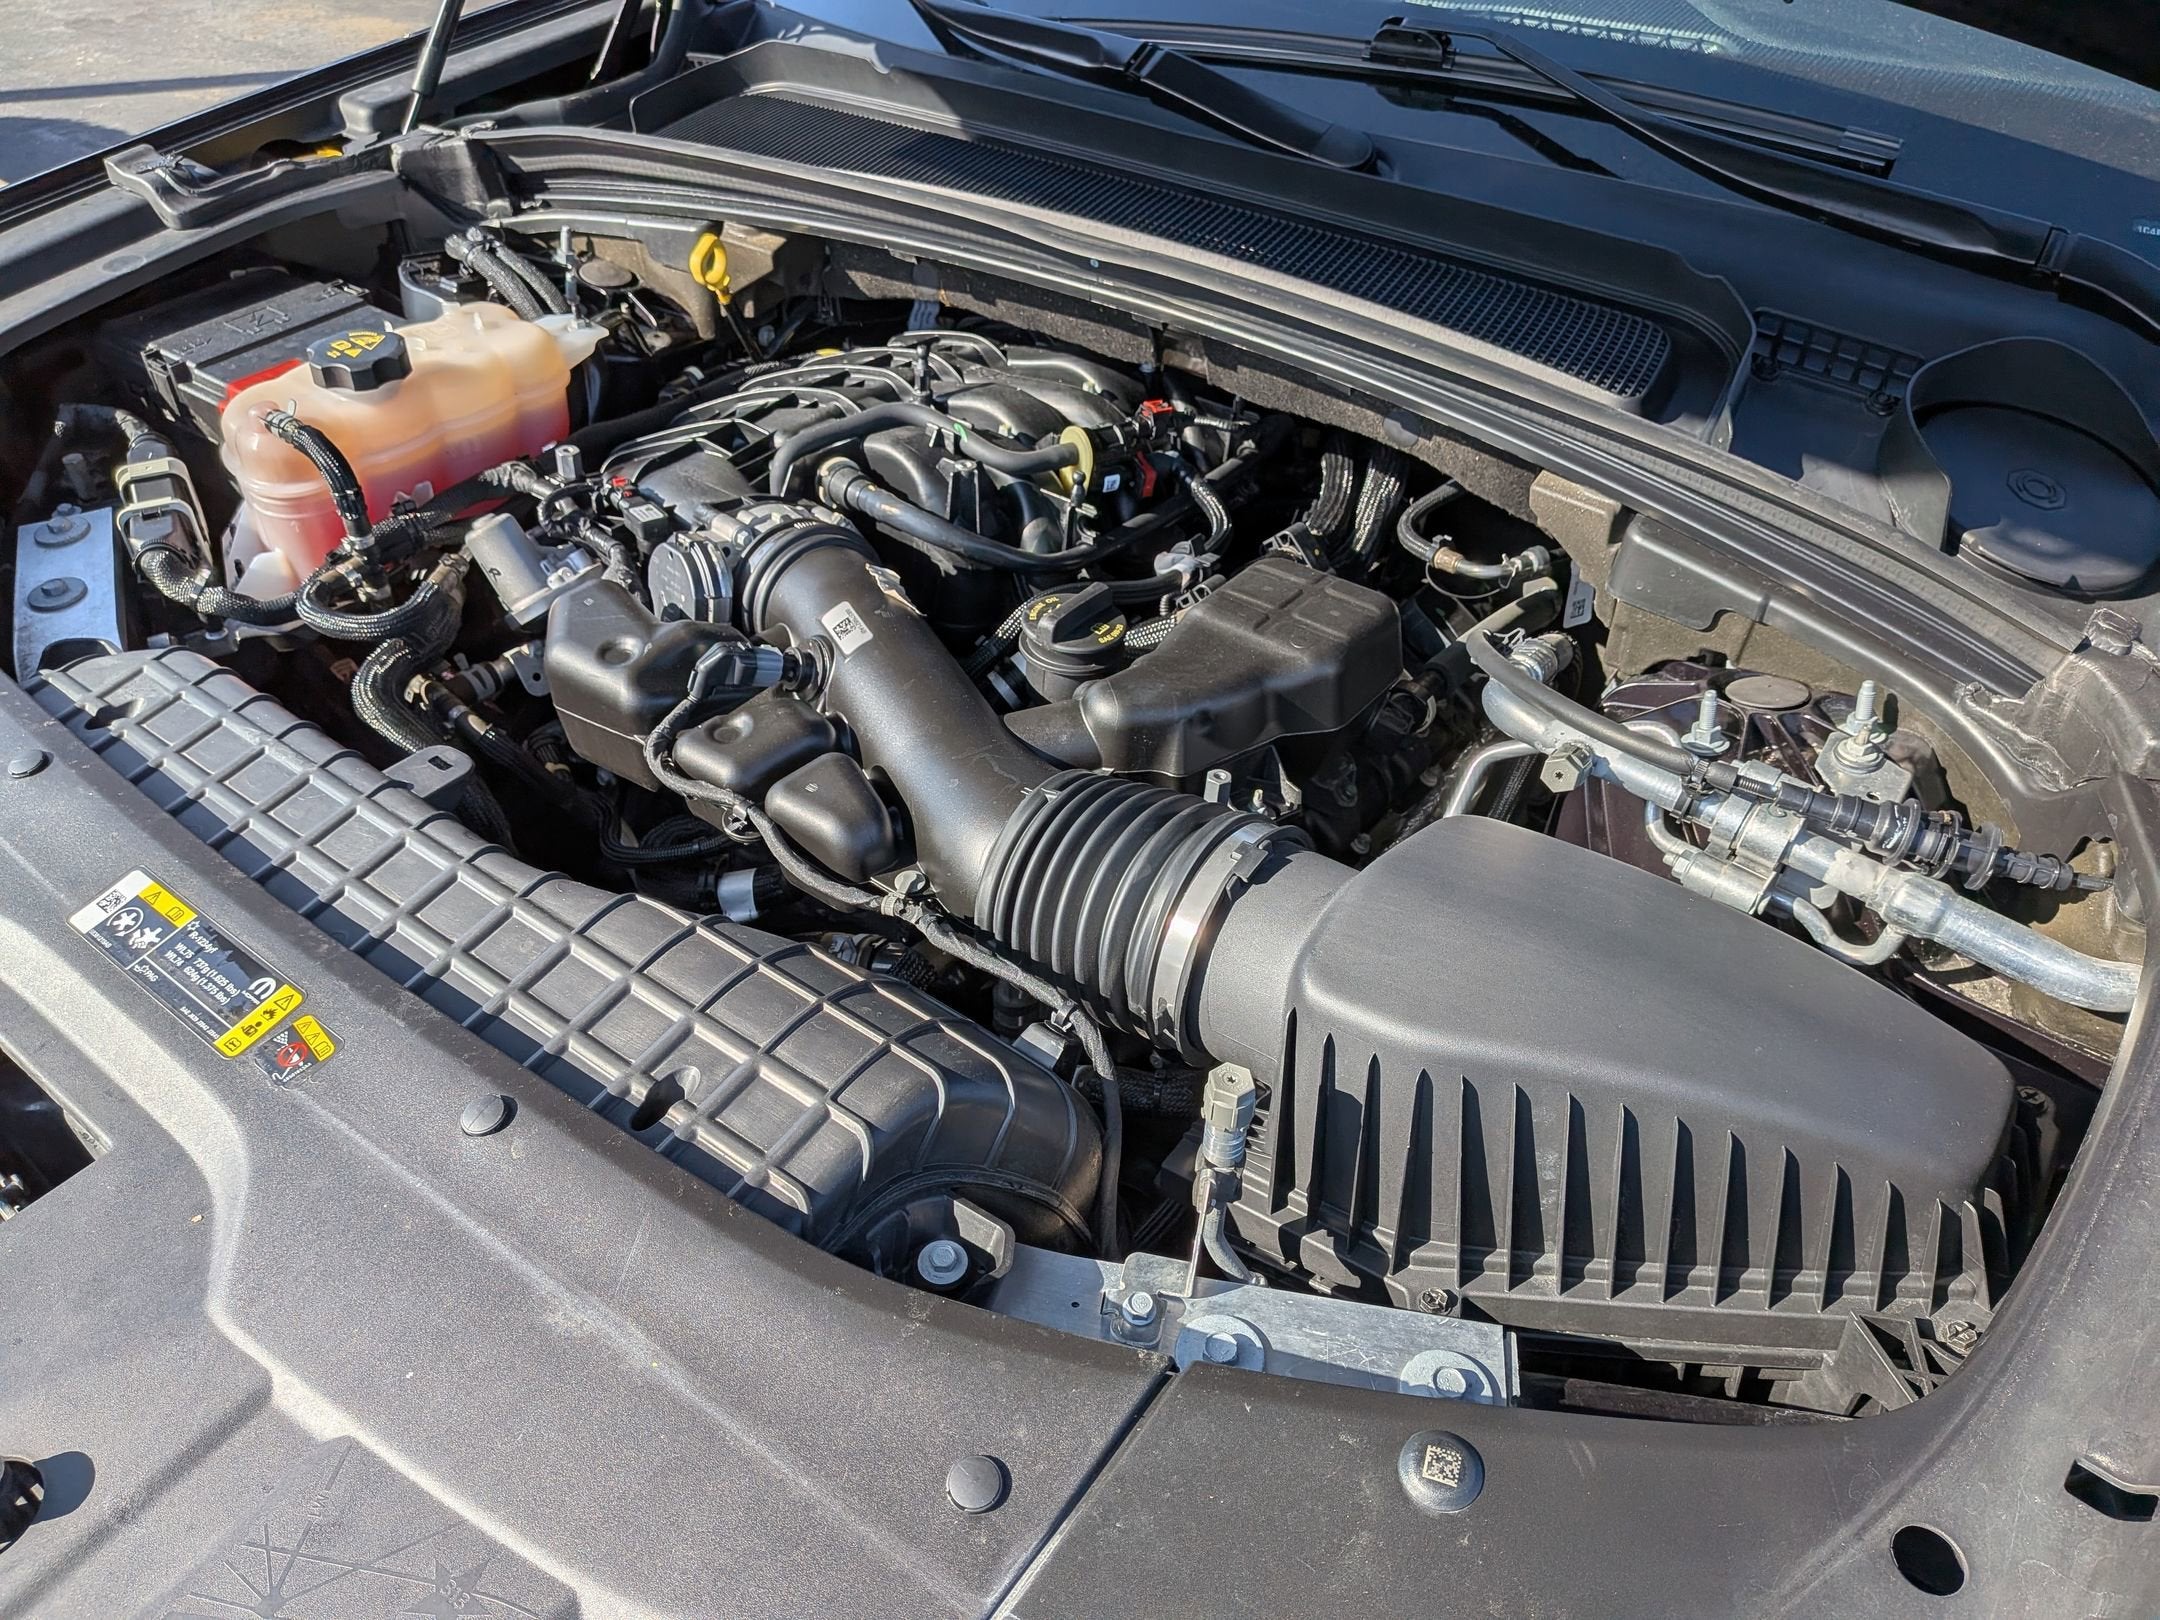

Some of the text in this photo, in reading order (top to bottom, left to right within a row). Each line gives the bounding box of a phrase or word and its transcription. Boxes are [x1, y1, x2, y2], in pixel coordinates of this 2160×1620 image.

[1029, 602, 1046, 620] ENGINE
[1098, 636, 1113, 644] SAE
[188, 930, 218, 954] R-1234yf
[143, 970, 159, 982] PAG
[164, 950, 231, 1005] WL74 624g (1.375 lbs)
[174, 942, 241, 997] WL75 737g (1.625 lbs)
